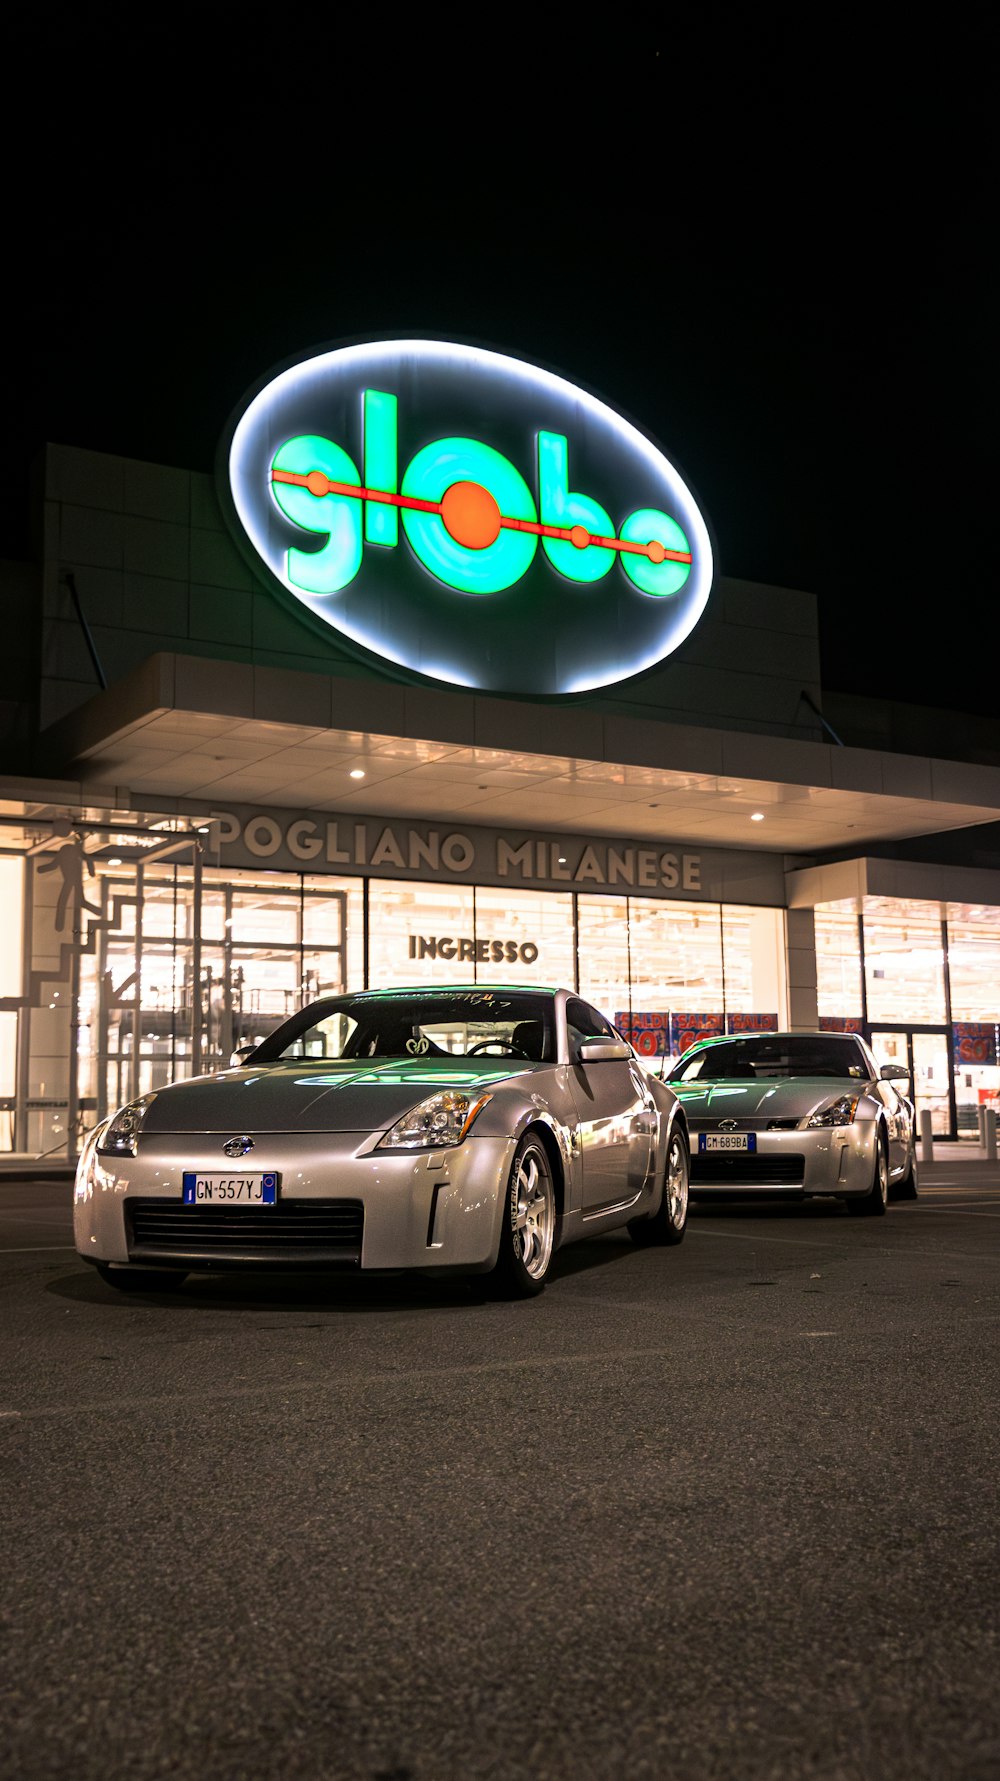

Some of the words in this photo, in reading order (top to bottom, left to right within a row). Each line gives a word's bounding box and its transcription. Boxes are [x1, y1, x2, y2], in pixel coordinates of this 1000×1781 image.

[210, 811, 475, 872] POGLIANO
[497, 838, 701, 891] MILANESE
[408, 936, 539, 965] INGRESSO
